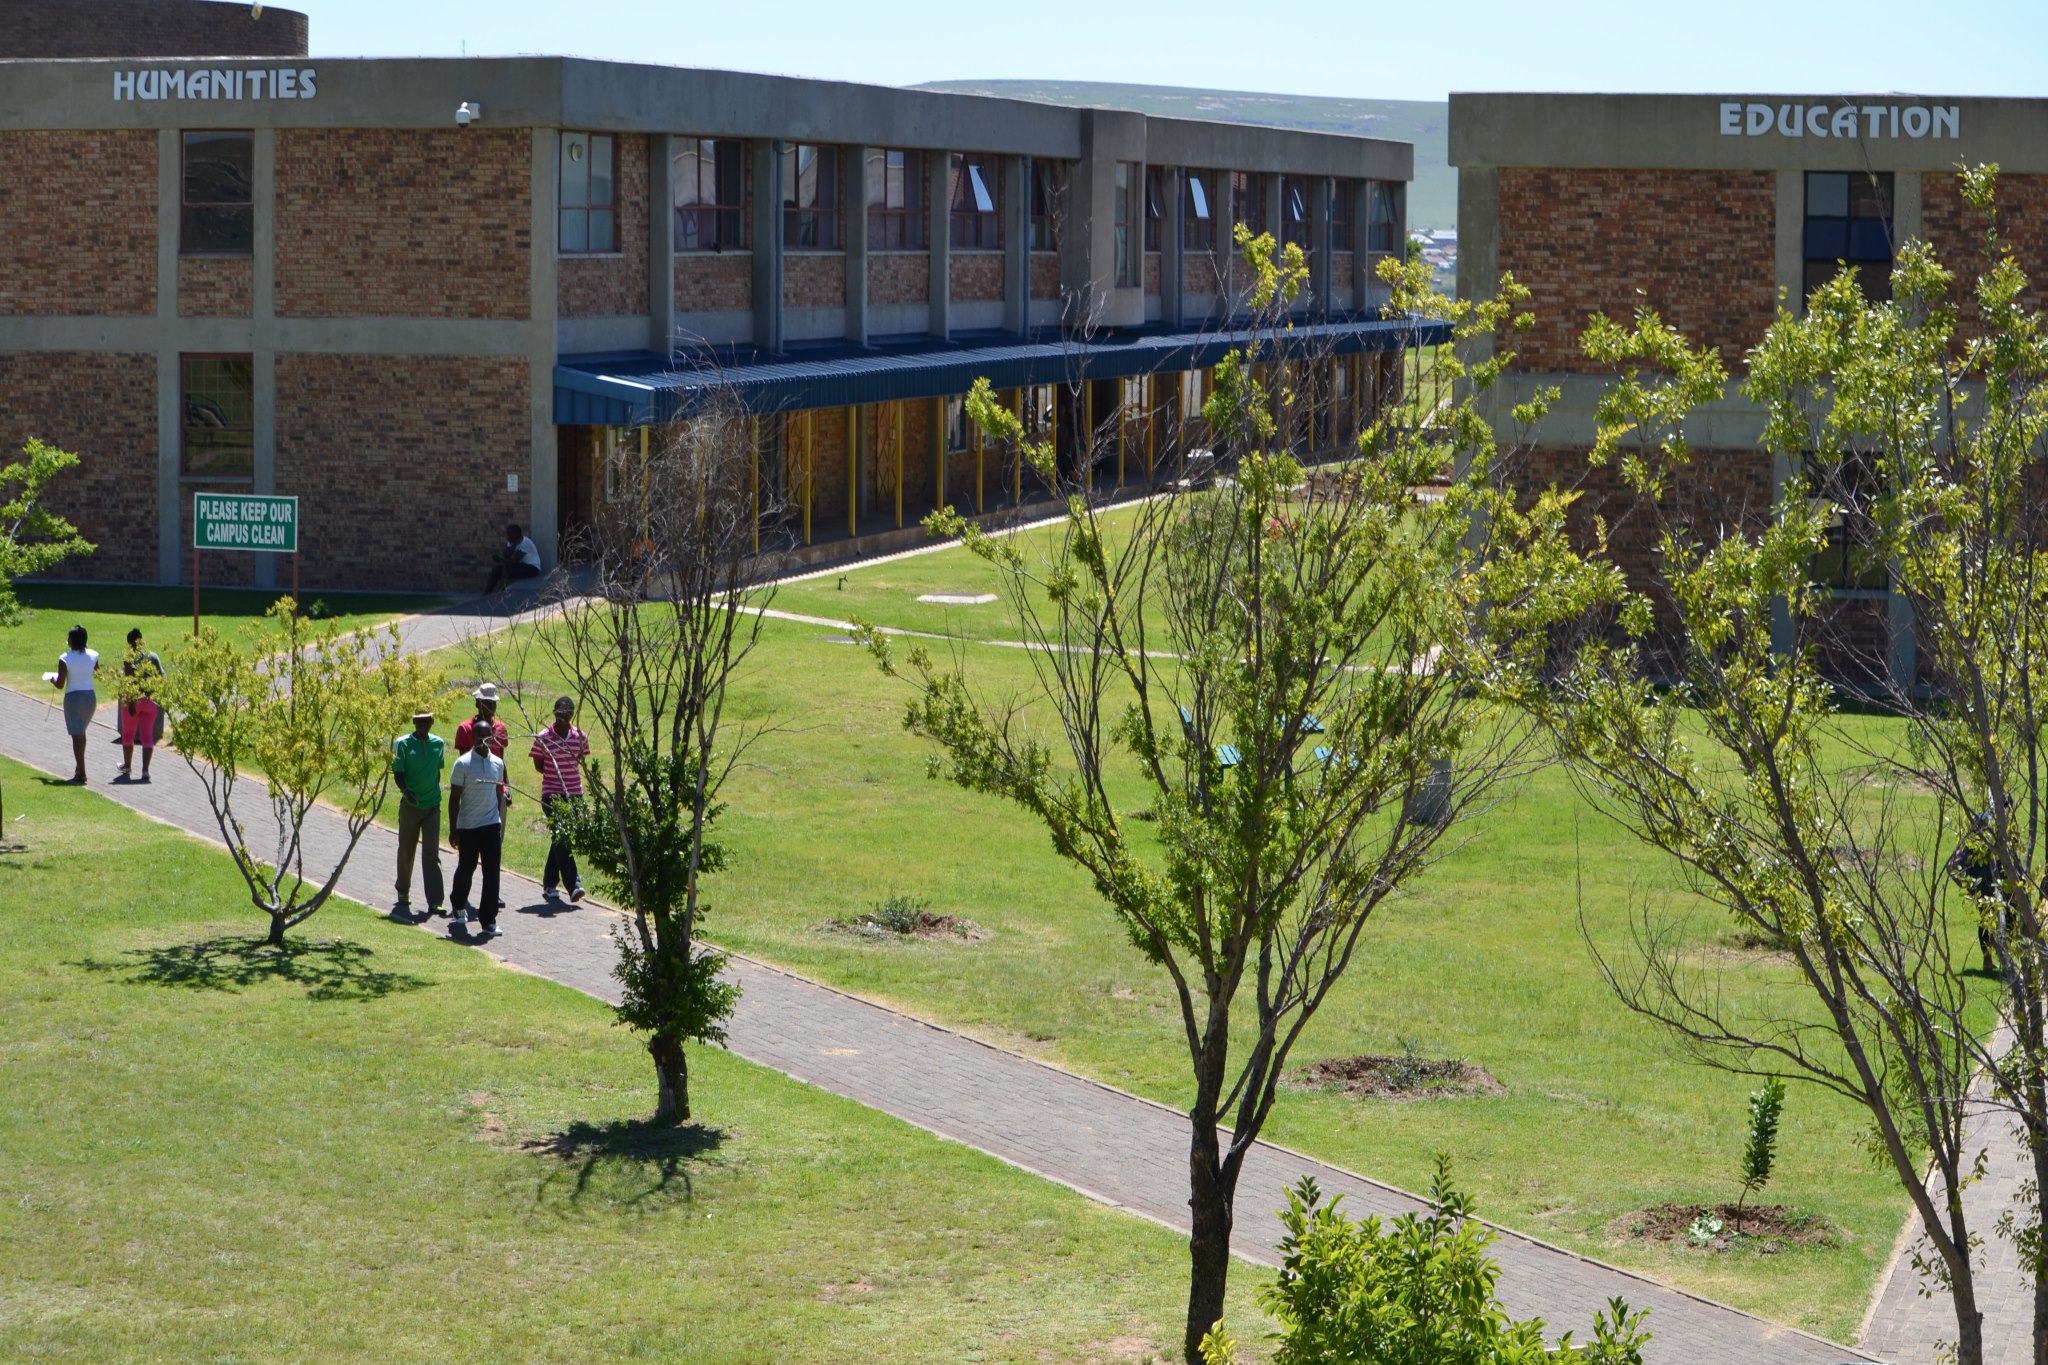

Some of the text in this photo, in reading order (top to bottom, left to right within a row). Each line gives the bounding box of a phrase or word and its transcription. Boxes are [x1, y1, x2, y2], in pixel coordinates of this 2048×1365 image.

[113, 68, 317, 100] HUMANITIES
[1720, 102, 1959, 138] EDUCATION
[200, 500, 292, 523] PLEASE KEEP OUR
[207, 522, 285, 545] CAMPUS CLEAN
